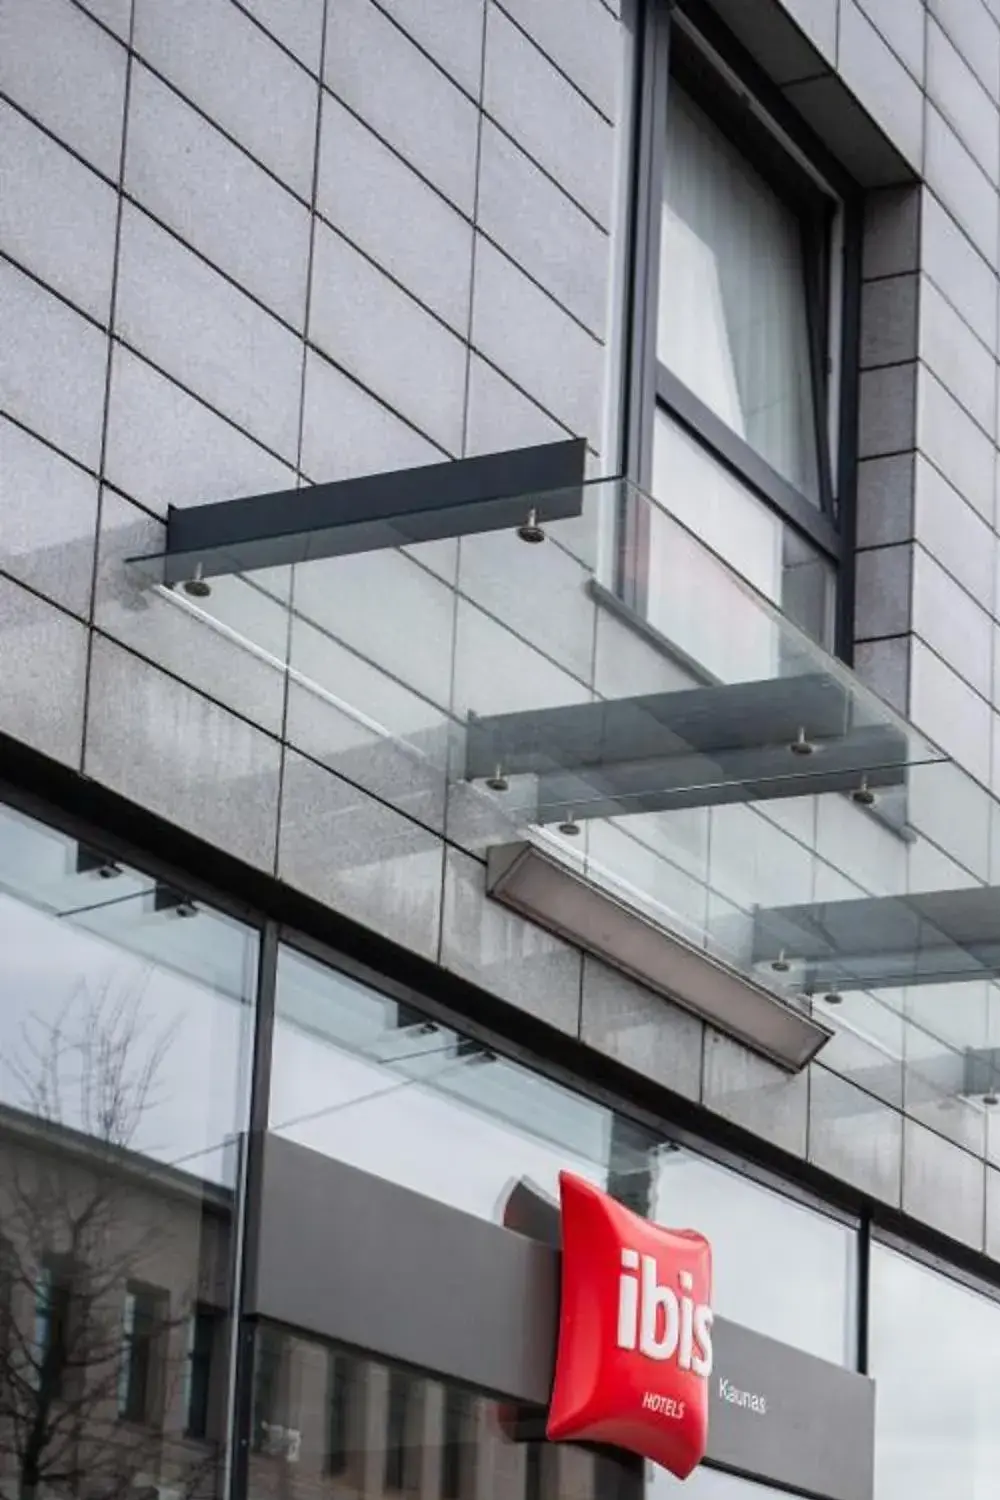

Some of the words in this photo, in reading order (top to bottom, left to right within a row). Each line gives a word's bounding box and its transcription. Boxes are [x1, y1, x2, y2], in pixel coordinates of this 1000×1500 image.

[615, 1248, 714, 1377] ibis
[641, 1390, 687, 1420] HOTELS
[718, 1377, 767, 1415] Kaunas
